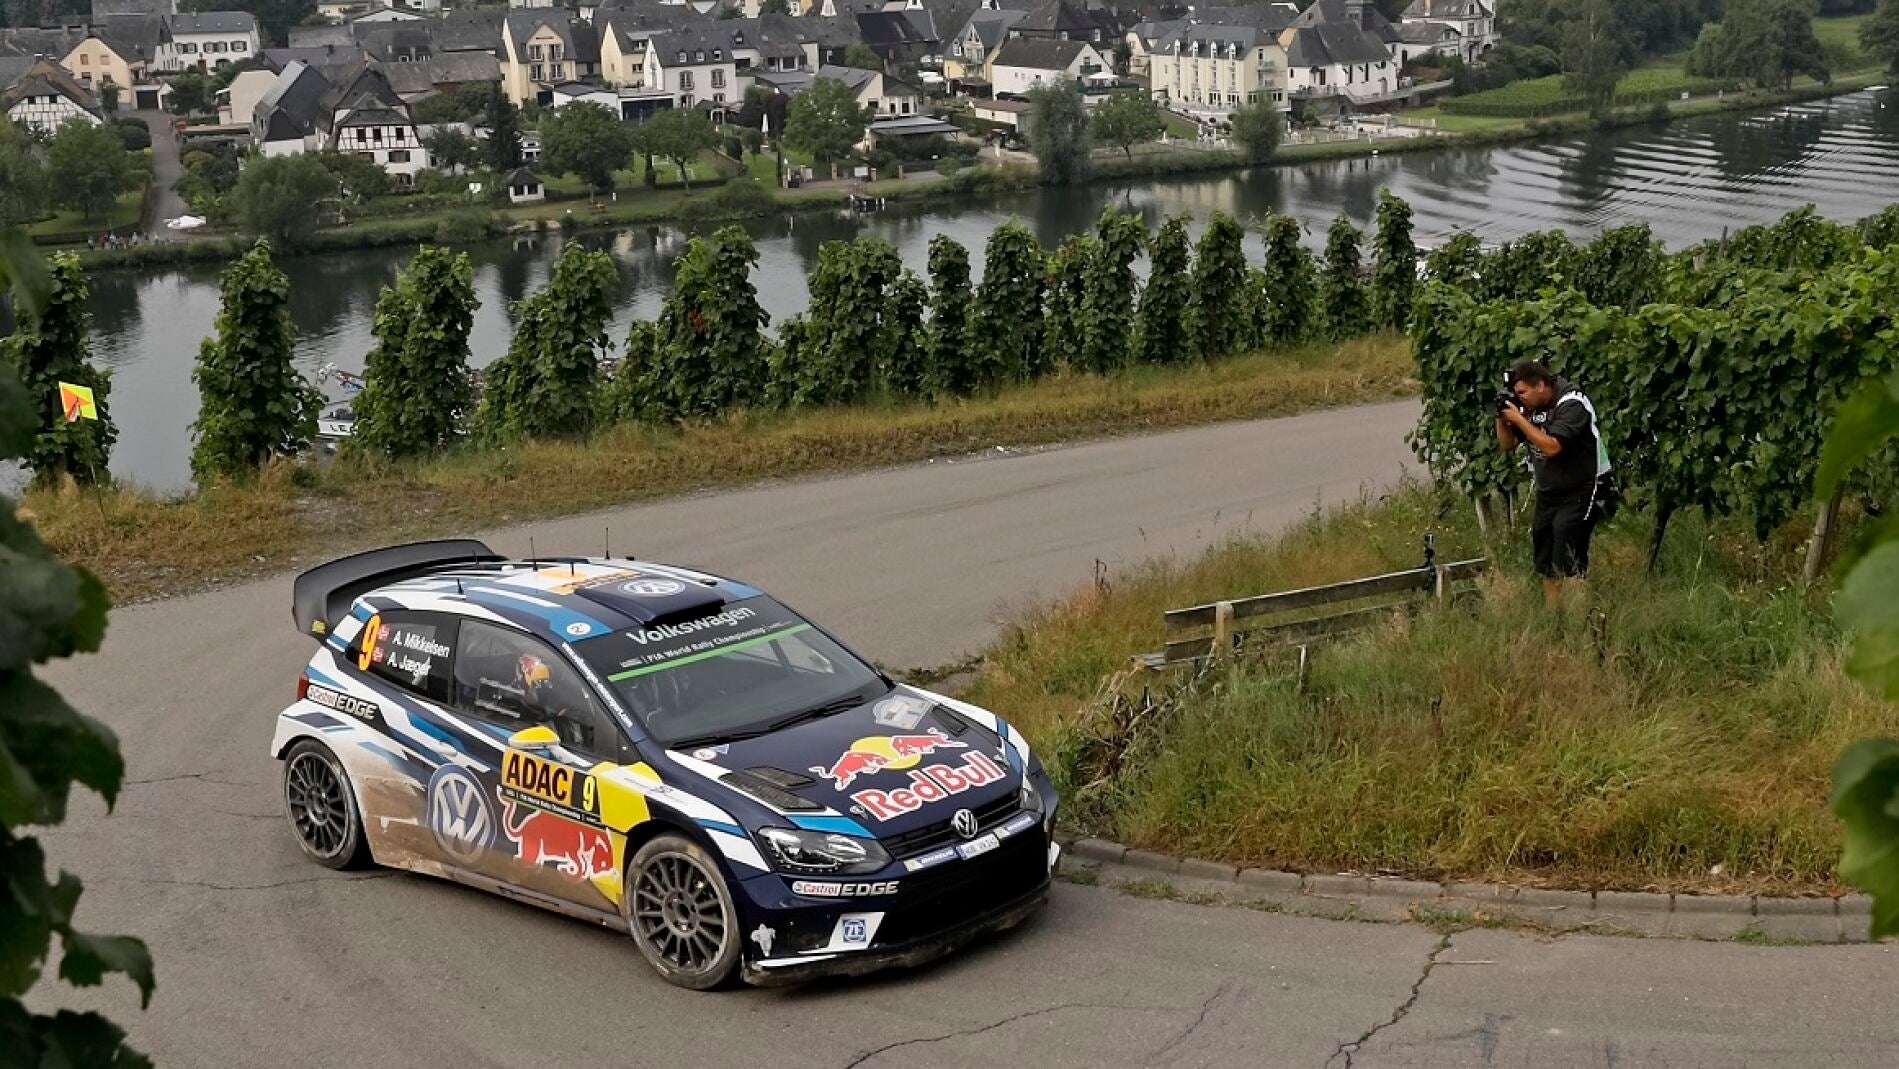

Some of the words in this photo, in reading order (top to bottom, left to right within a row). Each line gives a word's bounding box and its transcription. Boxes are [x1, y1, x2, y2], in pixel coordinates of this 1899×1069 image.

[358, 613, 382, 672] 9
[626, 606, 757, 645] Volkswagen
[386, 651, 398, 668] A.
[392, 630, 402, 646] A.
[404, 631, 450, 658] Mikkelsen
[646, 652, 665, 662] FIA
[664, 646, 692, 657] World
[691, 640, 714, 650] Rally
[713, 627, 767, 645] Championship
[336, 695, 378, 720] EDGE
[505, 753, 568, 801] ADAC
[582, 775, 596, 812] 9
[850, 769, 949, 822] Red
[922, 750, 1007, 795] Bull
[803, 884, 839, 895] Castrol
[840, 880, 900, 897] EDGE
